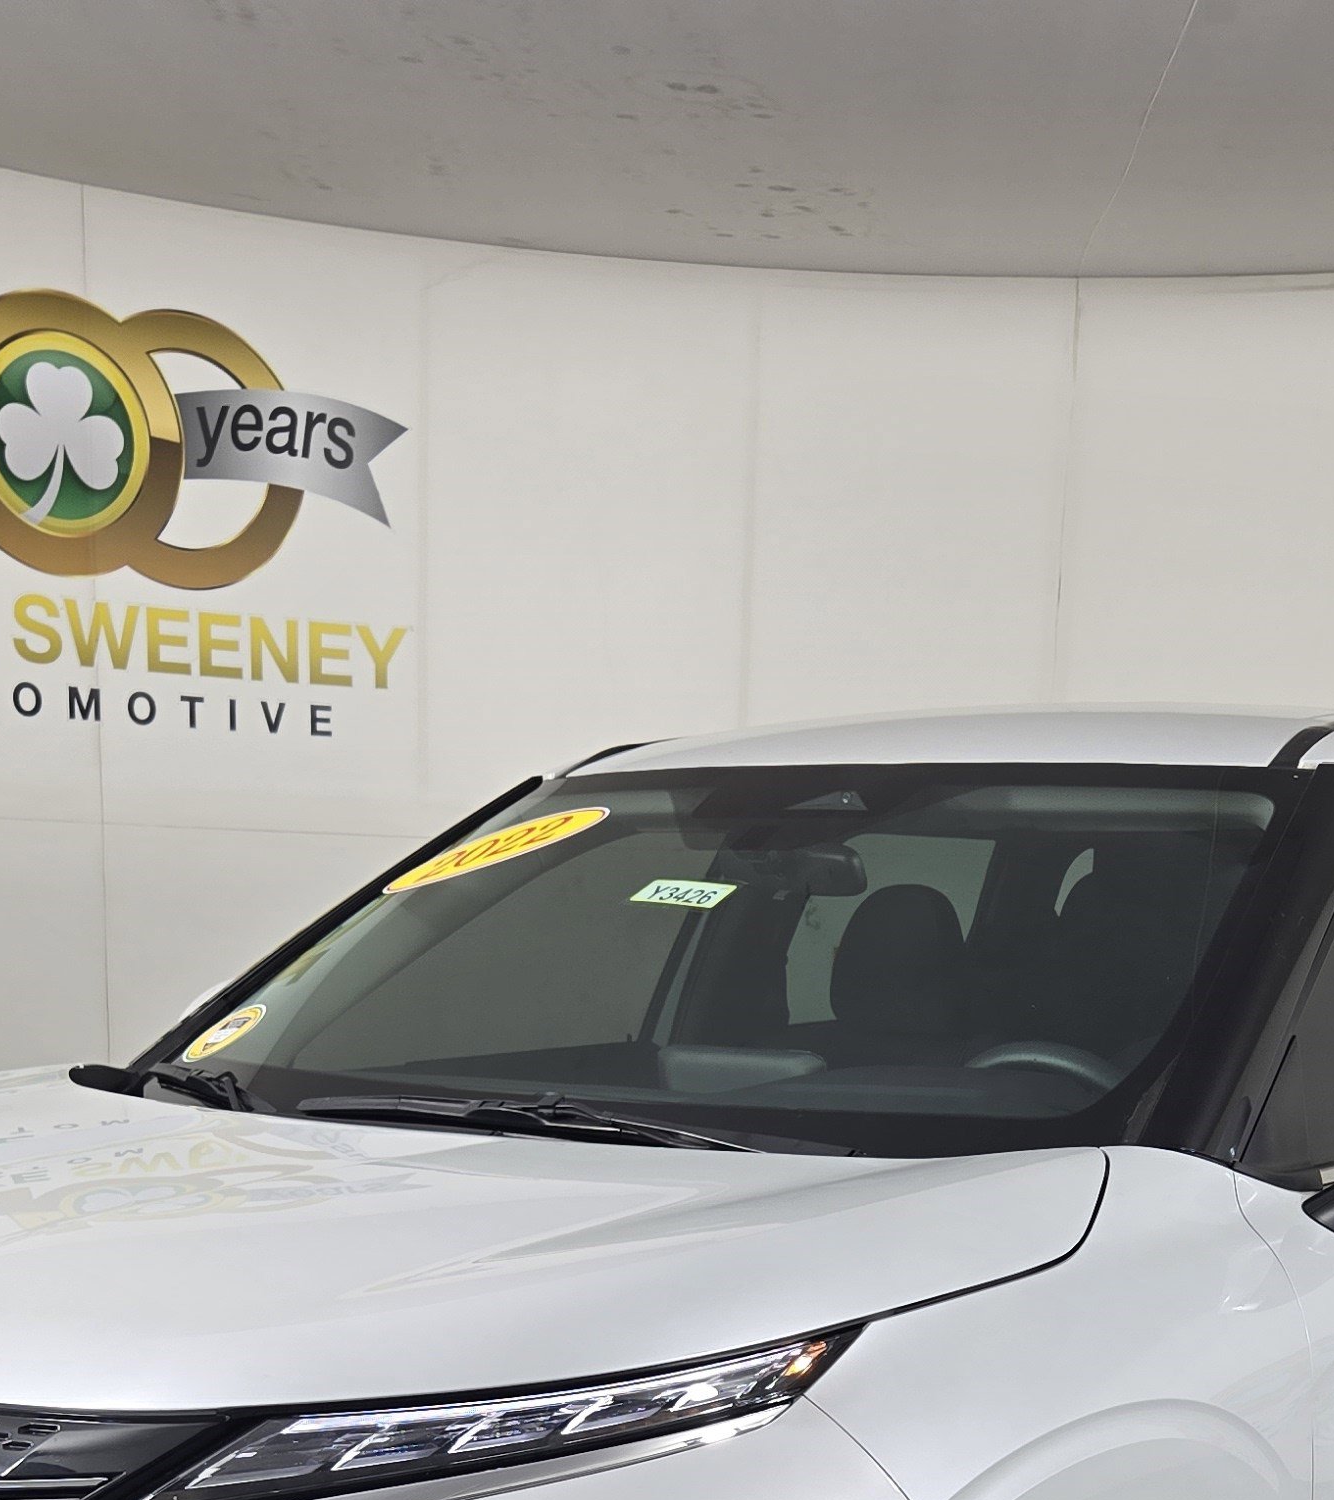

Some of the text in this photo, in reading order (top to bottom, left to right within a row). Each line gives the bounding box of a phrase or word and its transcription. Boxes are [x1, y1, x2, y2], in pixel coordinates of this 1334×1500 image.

[194, 402, 357, 470] years
[12, 593, 410, 690] SWEENEY
[414, 815, 574, 883] 2022
[647, 885, 718, 905] Y3426
